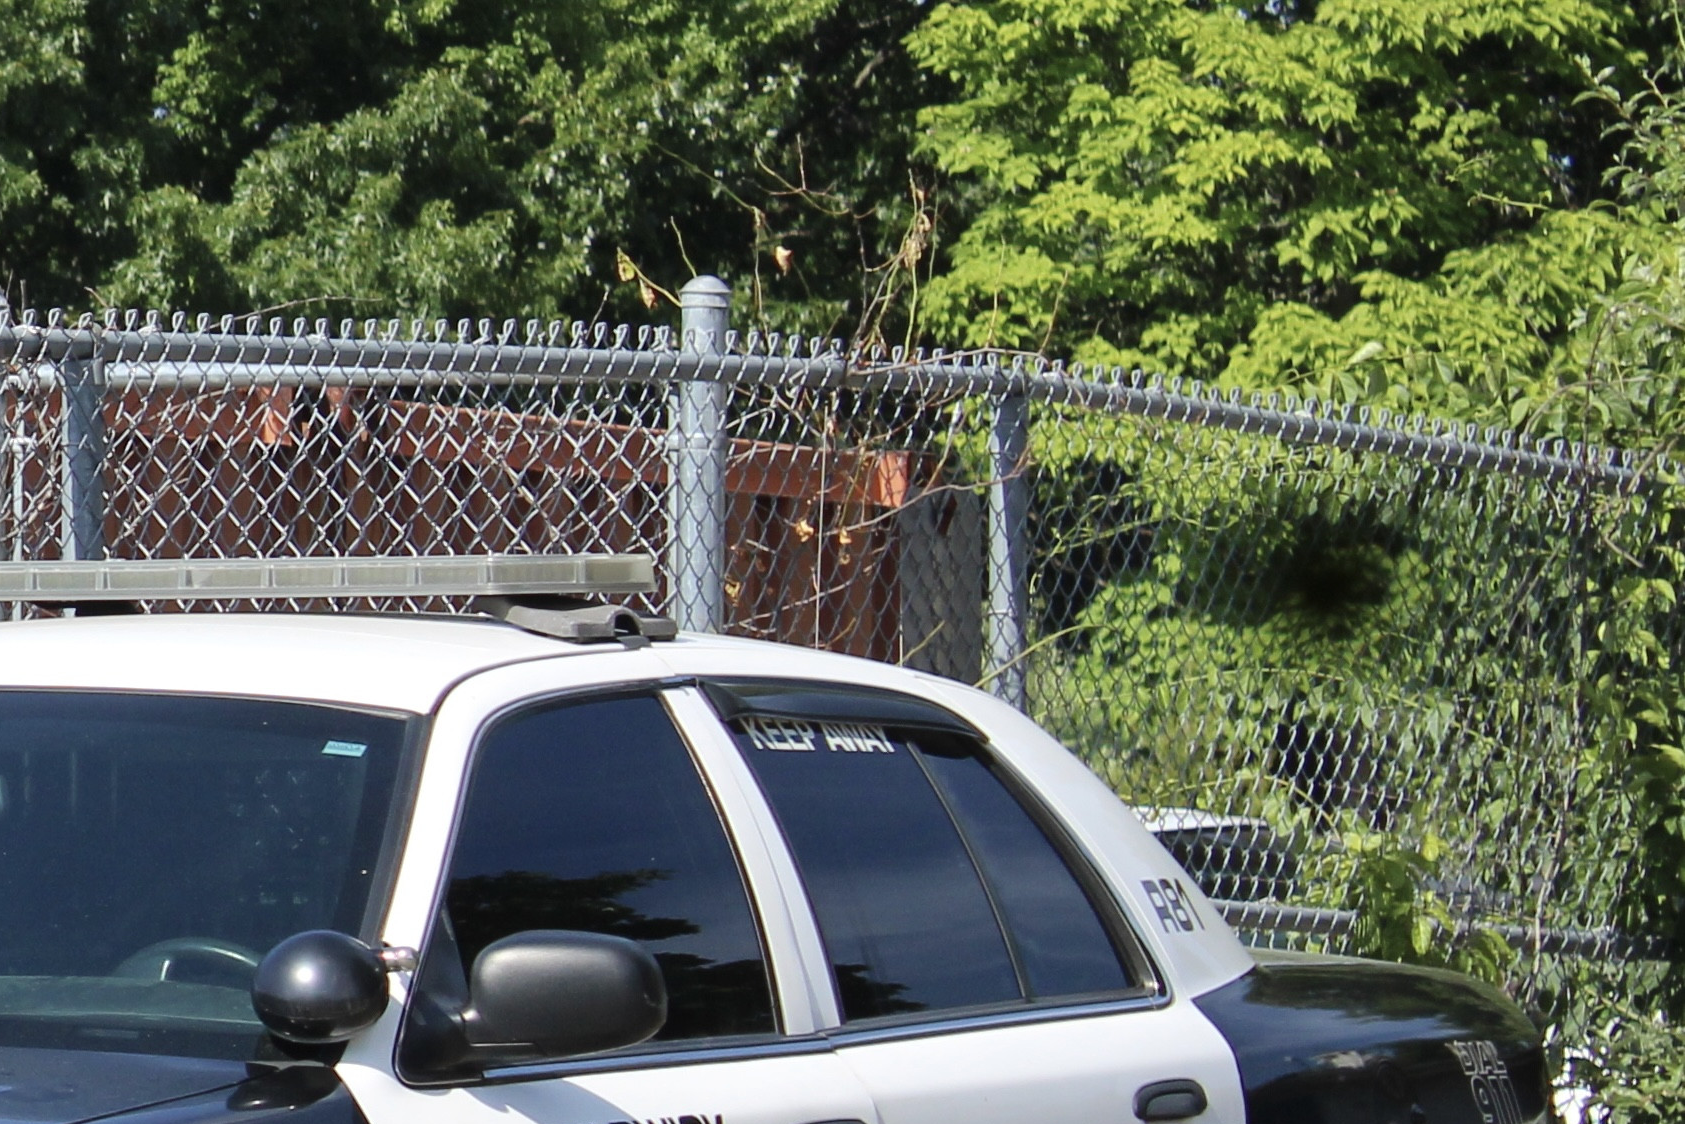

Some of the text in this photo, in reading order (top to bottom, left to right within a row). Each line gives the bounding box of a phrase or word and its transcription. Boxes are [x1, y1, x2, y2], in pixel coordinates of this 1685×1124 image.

[739, 717, 895, 753] KEEP AWAY
[1140, 878, 1205, 934] R81
[1445, 1040, 1507, 1075] DIAL
